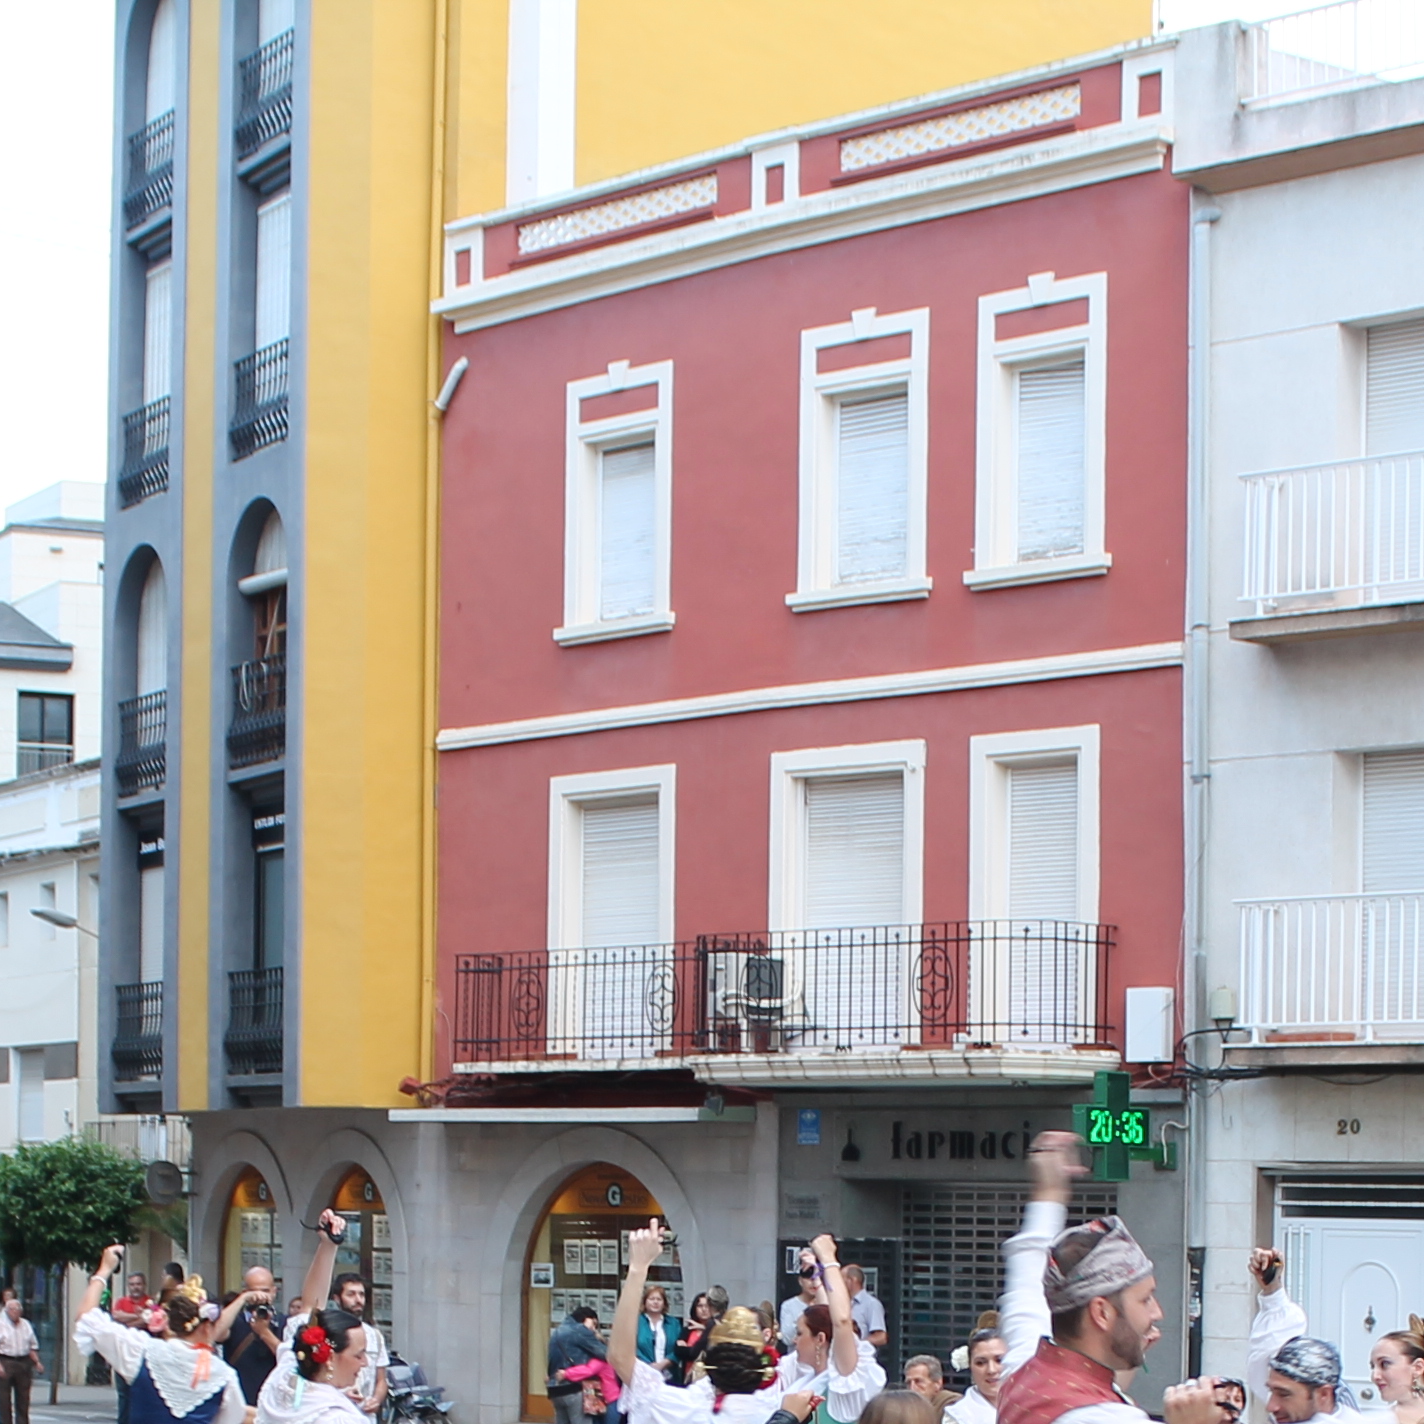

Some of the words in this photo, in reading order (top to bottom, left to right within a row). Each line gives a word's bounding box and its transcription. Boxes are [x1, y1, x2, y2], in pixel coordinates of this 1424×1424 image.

[890, 1120, 1031, 1161] farmaci
[1089, 1109, 1144, 1144] 20:36
[1336, 1118, 1362, 1136] 20
[607, 1184, 622, 1207] G
